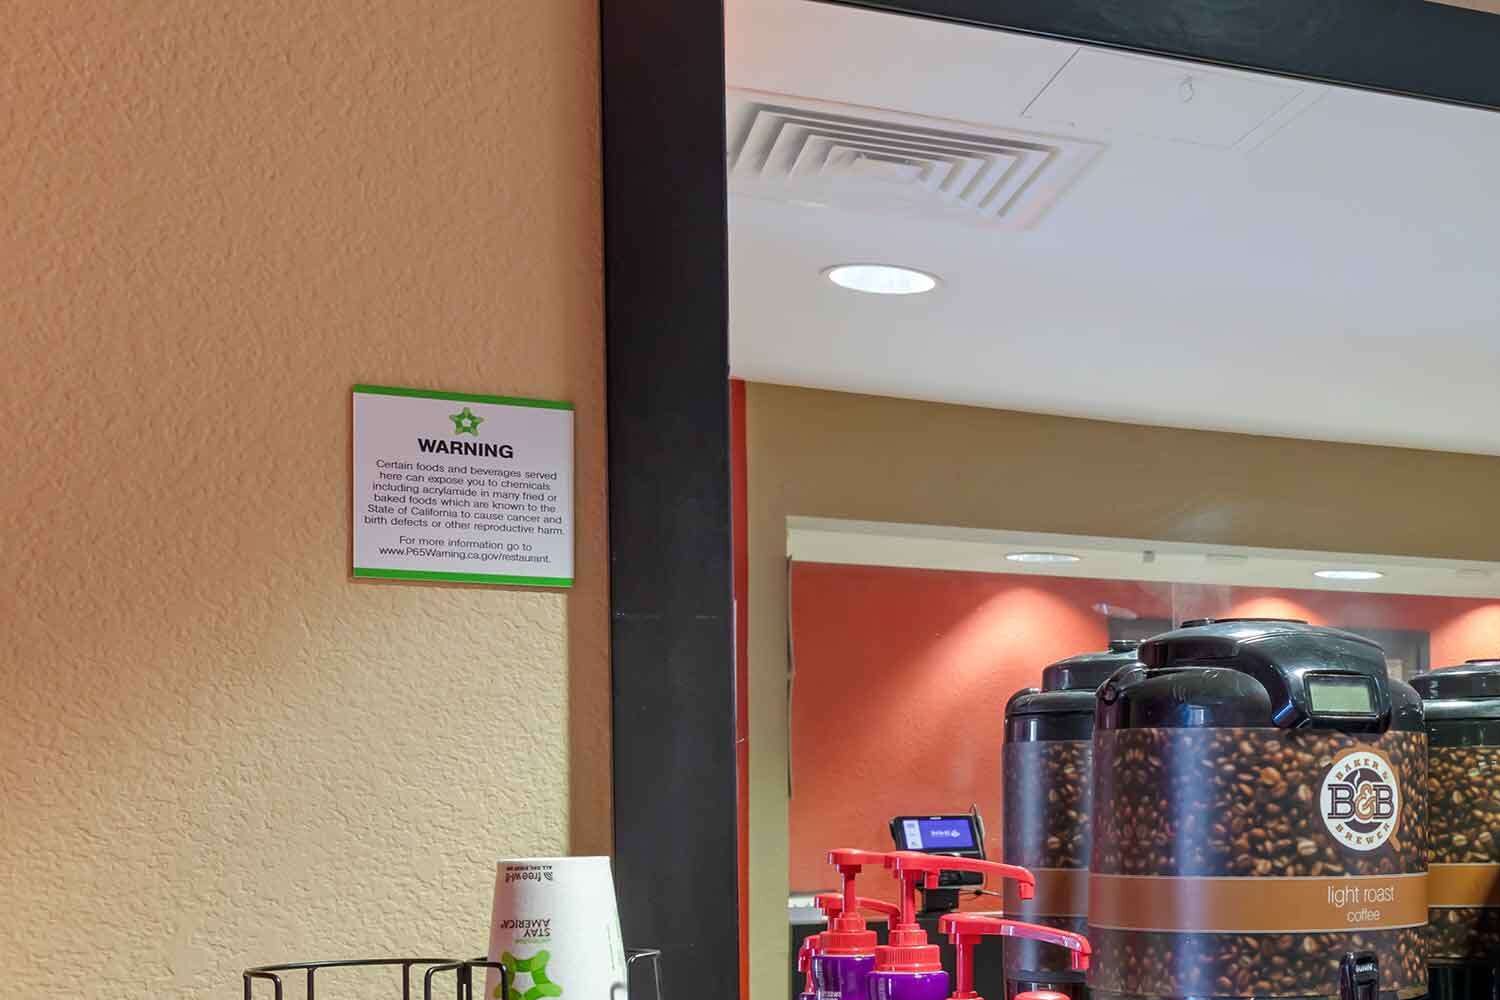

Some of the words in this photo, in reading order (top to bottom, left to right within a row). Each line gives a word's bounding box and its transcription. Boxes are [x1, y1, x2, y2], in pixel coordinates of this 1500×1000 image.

[418, 438, 513, 458] WARNING
[376, 460, 413, 471] Certain
[416, 463, 444, 473] foods
[448, 465, 467, 473] and
[471, 467, 521, 479] beverages
[525, 470, 557, 480] served
[380, 471, 402, 481] here
[428, 475, 464, 487] expose
[467, 479, 485, 487] you
[373, 482, 419, 494] including
[423, 485, 477, 497] acrylamide
[493, 490, 519, 501] many
[523, 491, 544, 501] fried
[374, 494, 406, 503] baked
[409, 496, 437, 505] foods
[441, 498, 470, 508] which
[492, 501, 524, 511] known
[528, 503, 537, 511] to
[541, 504, 556, 513] the
[368, 505, 394, 514] State
[398, 506, 408, 515] of
[411, 507, 457, 518] California
[461, 510, 470, 518] to
[474, 512, 504, 521] cause
[507, 514, 540, 523] cancer
[543, 515, 562, 524] and
[365, 516, 387, 525] birth
[391, 517, 428, 528] defects
[445, 520, 470, 529] other
[474, 522, 534, 534] reproductive
[538, 526, 564, 535] harm.
[400, 536, 415, 545] For
[419, 538, 445, 546] more
[448, 538, 503, 550] information
[507, 543, 519, 551] go
[523, 543, 532, 551] to
[1336, 758, 1379, 781] BAKER
[1328, 780, 1394, 820] B&B
[1336, 823, 1390, 845] BREWER
[1328, 885, 1359, 908] light
[1363, 886, 1394, 902] roast
[1347, 908, 1380, 922] coffee
[524, 928, 550, 937] STAY
